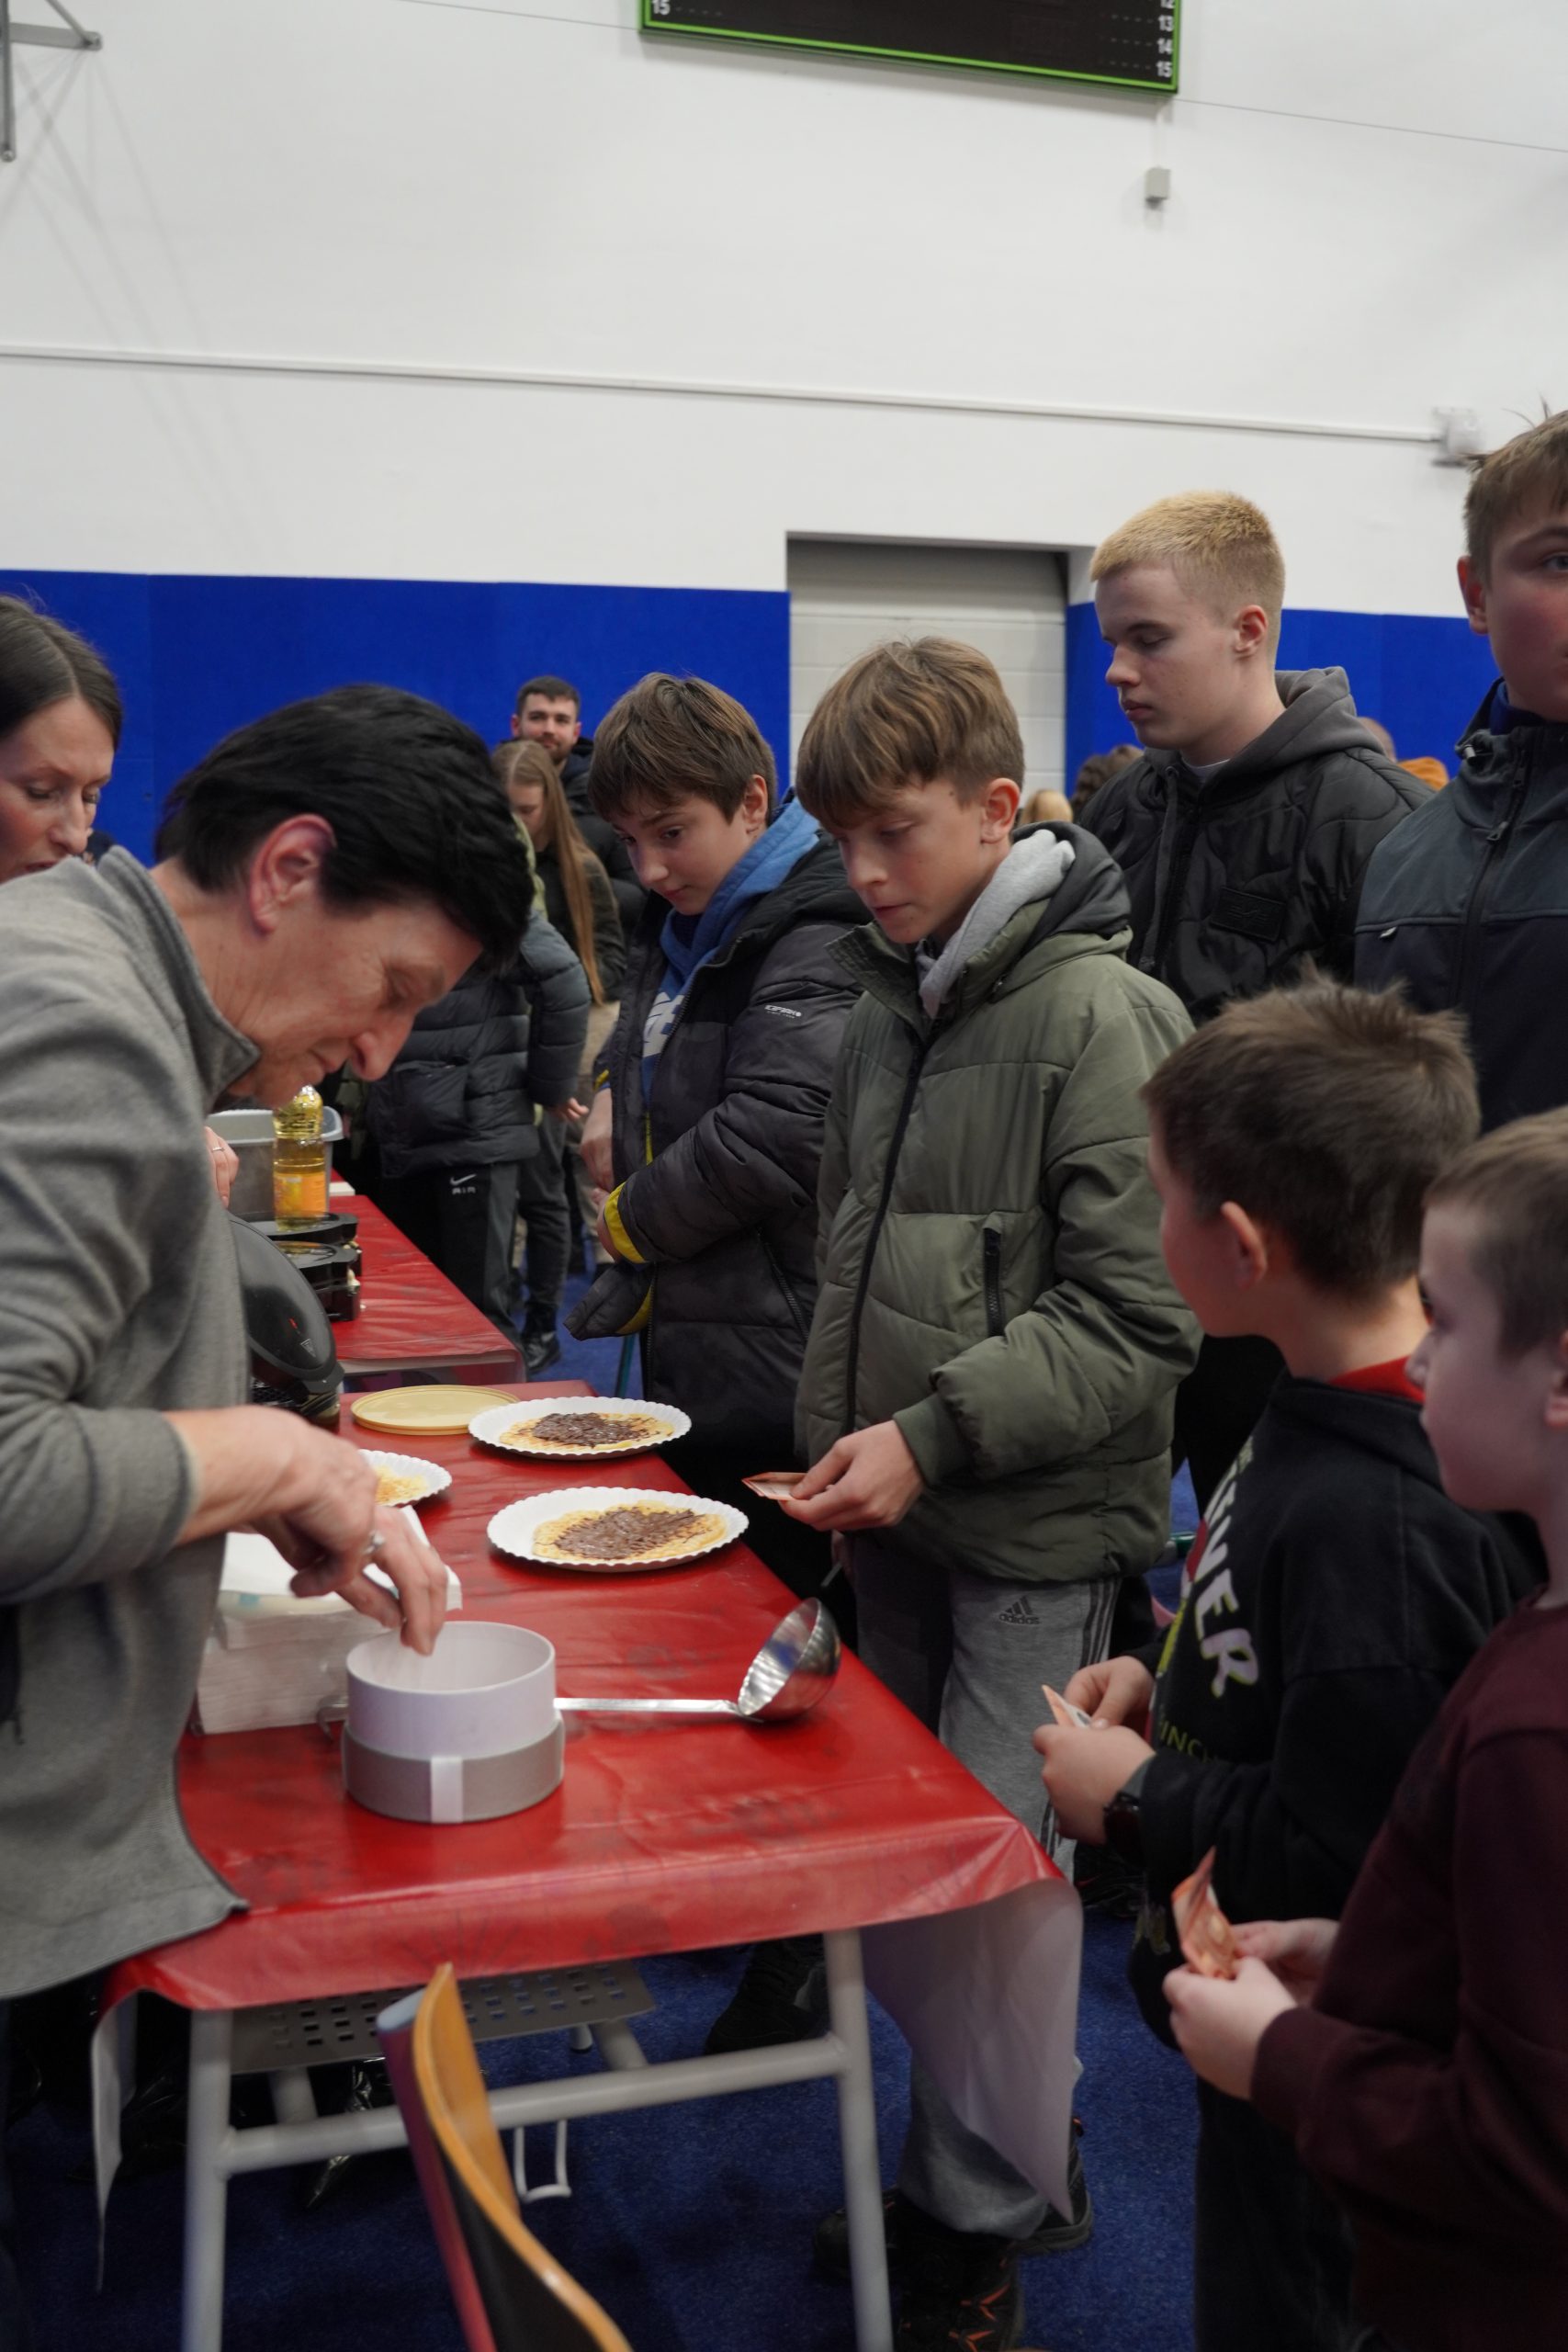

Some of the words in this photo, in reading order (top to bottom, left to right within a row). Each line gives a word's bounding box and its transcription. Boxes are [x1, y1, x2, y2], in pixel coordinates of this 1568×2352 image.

[652, 0, 671, 16] 15
[1157, 15, 1174, 32] 13
[1156, 38, 1173, 55] 14
[1156, 61, 1173, 78] 15
